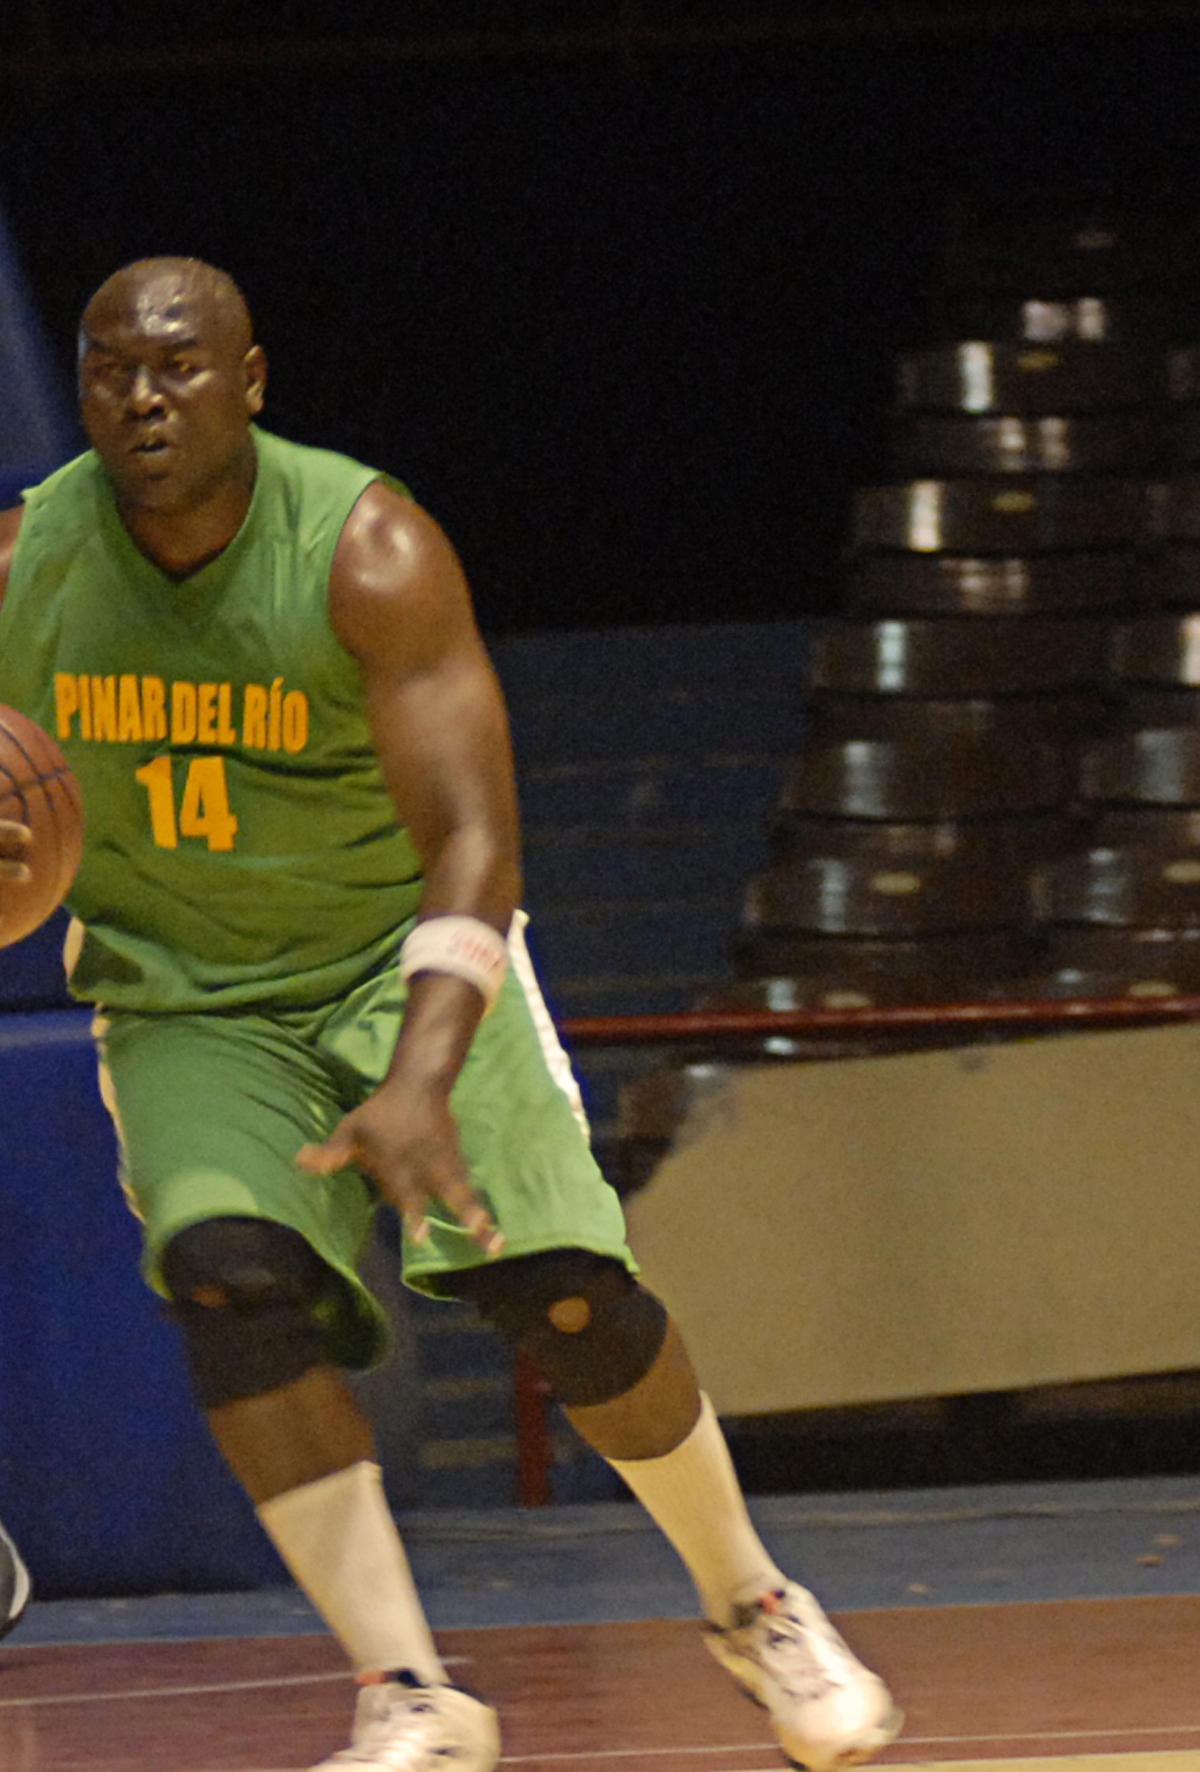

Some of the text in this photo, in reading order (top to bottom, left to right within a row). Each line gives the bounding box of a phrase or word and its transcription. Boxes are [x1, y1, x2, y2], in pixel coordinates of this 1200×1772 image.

[54, 672, 309, 754] PINAR DEL RÍO
[136, 755, 238, 851] 14
